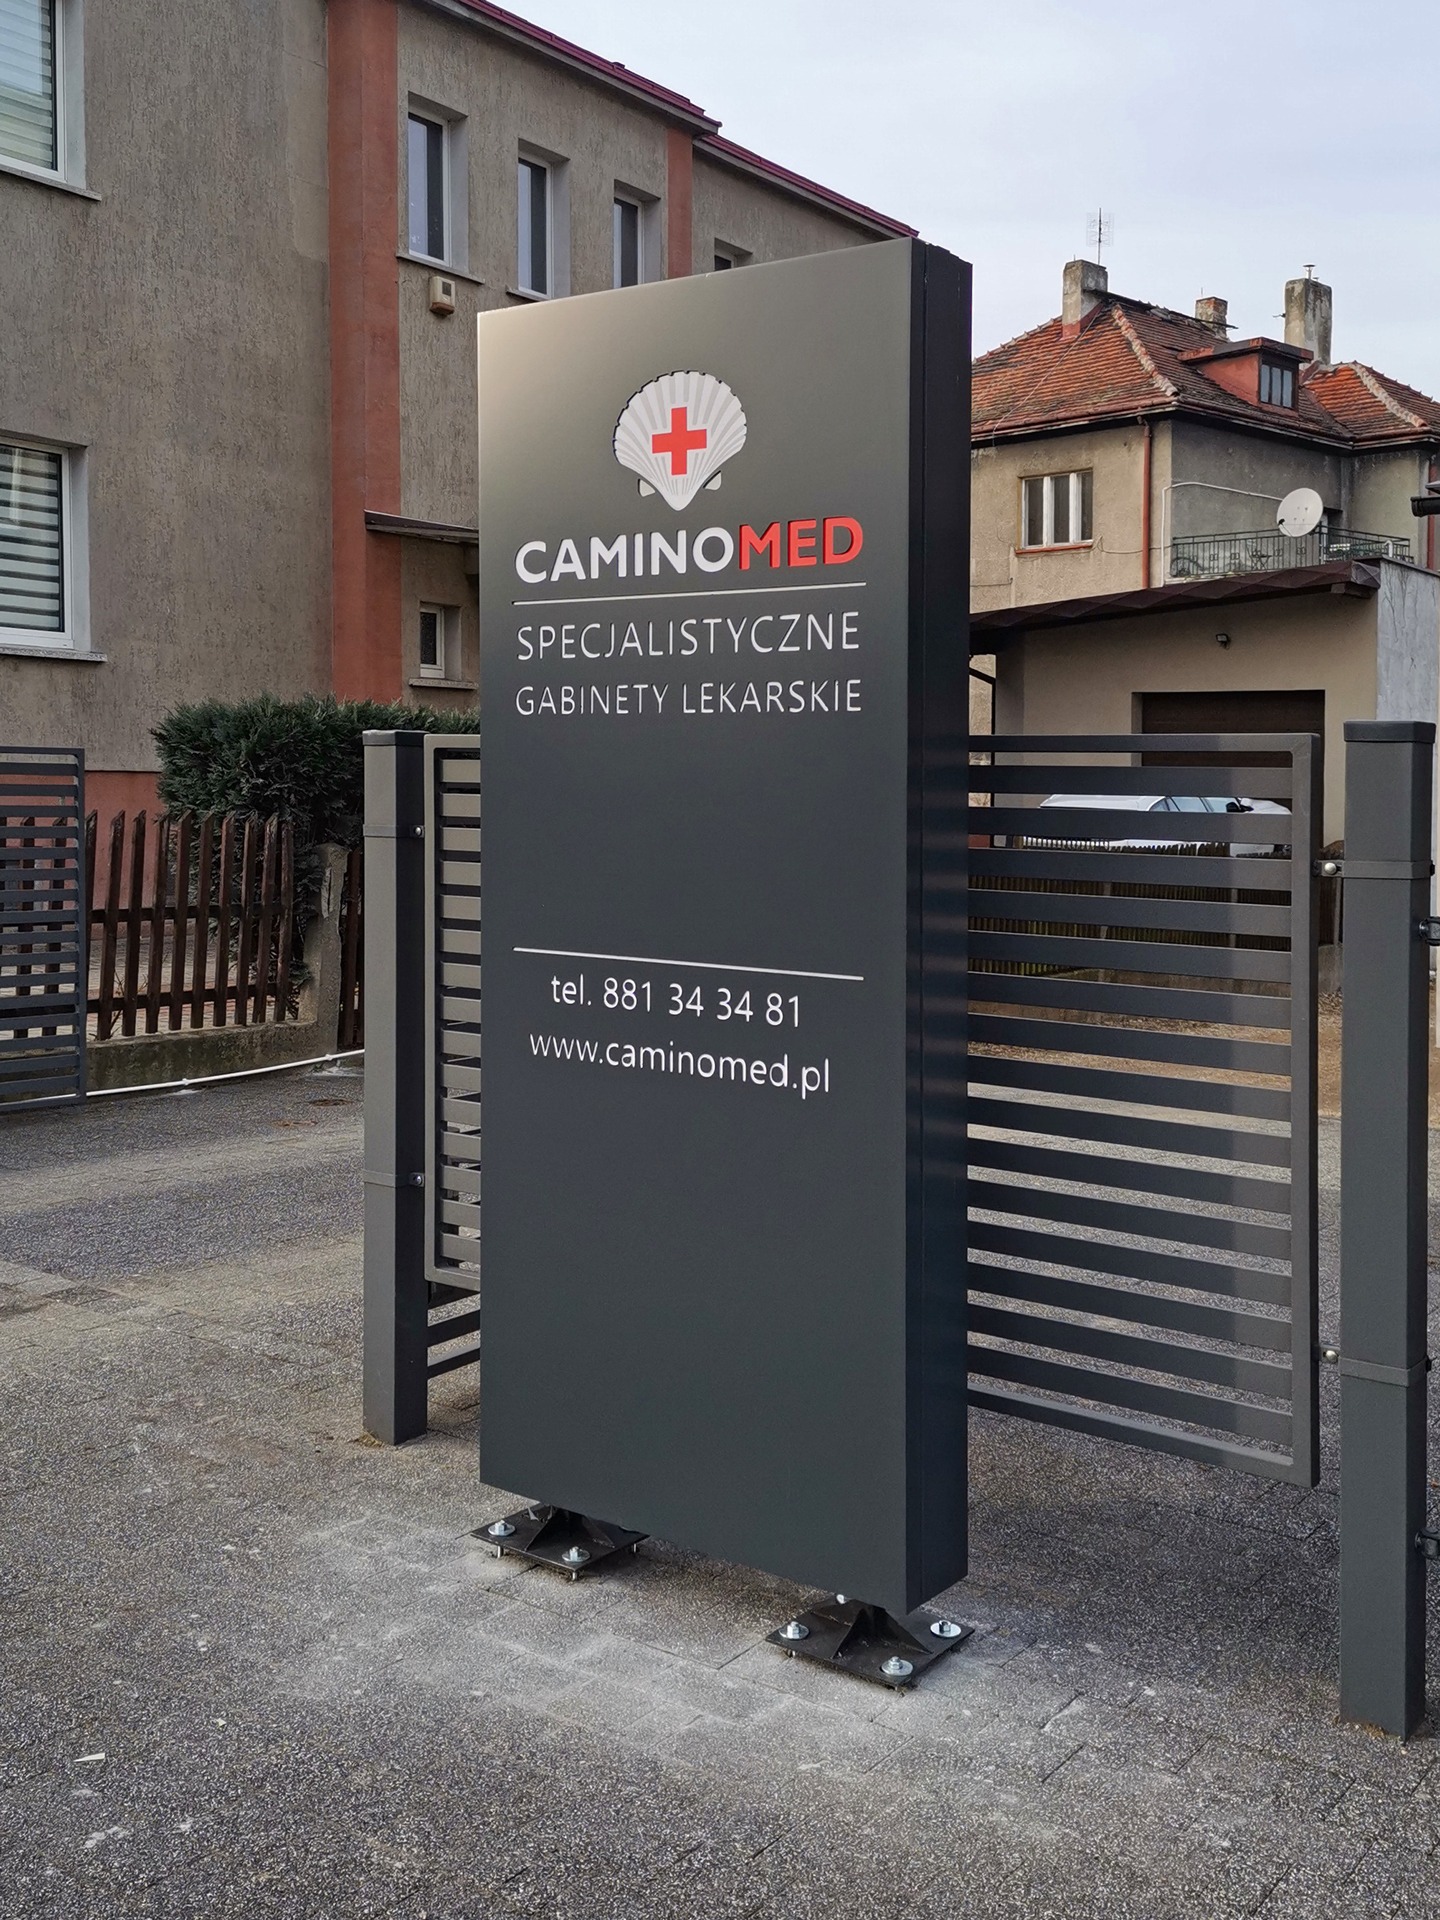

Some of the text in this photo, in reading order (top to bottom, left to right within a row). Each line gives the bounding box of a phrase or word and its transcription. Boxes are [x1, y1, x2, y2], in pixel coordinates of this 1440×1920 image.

[515, 516, 865, 584] CAMINOMED
[516, 611, 861, 661] SPECJALISTYCZNE
[515, 679, 862, 716] GABINETY LEKARSKIE
[551, 973, 800, 1028] tel. 881 34 34 81
[529, 1033, 830, 1100] www.caminomed.pl
